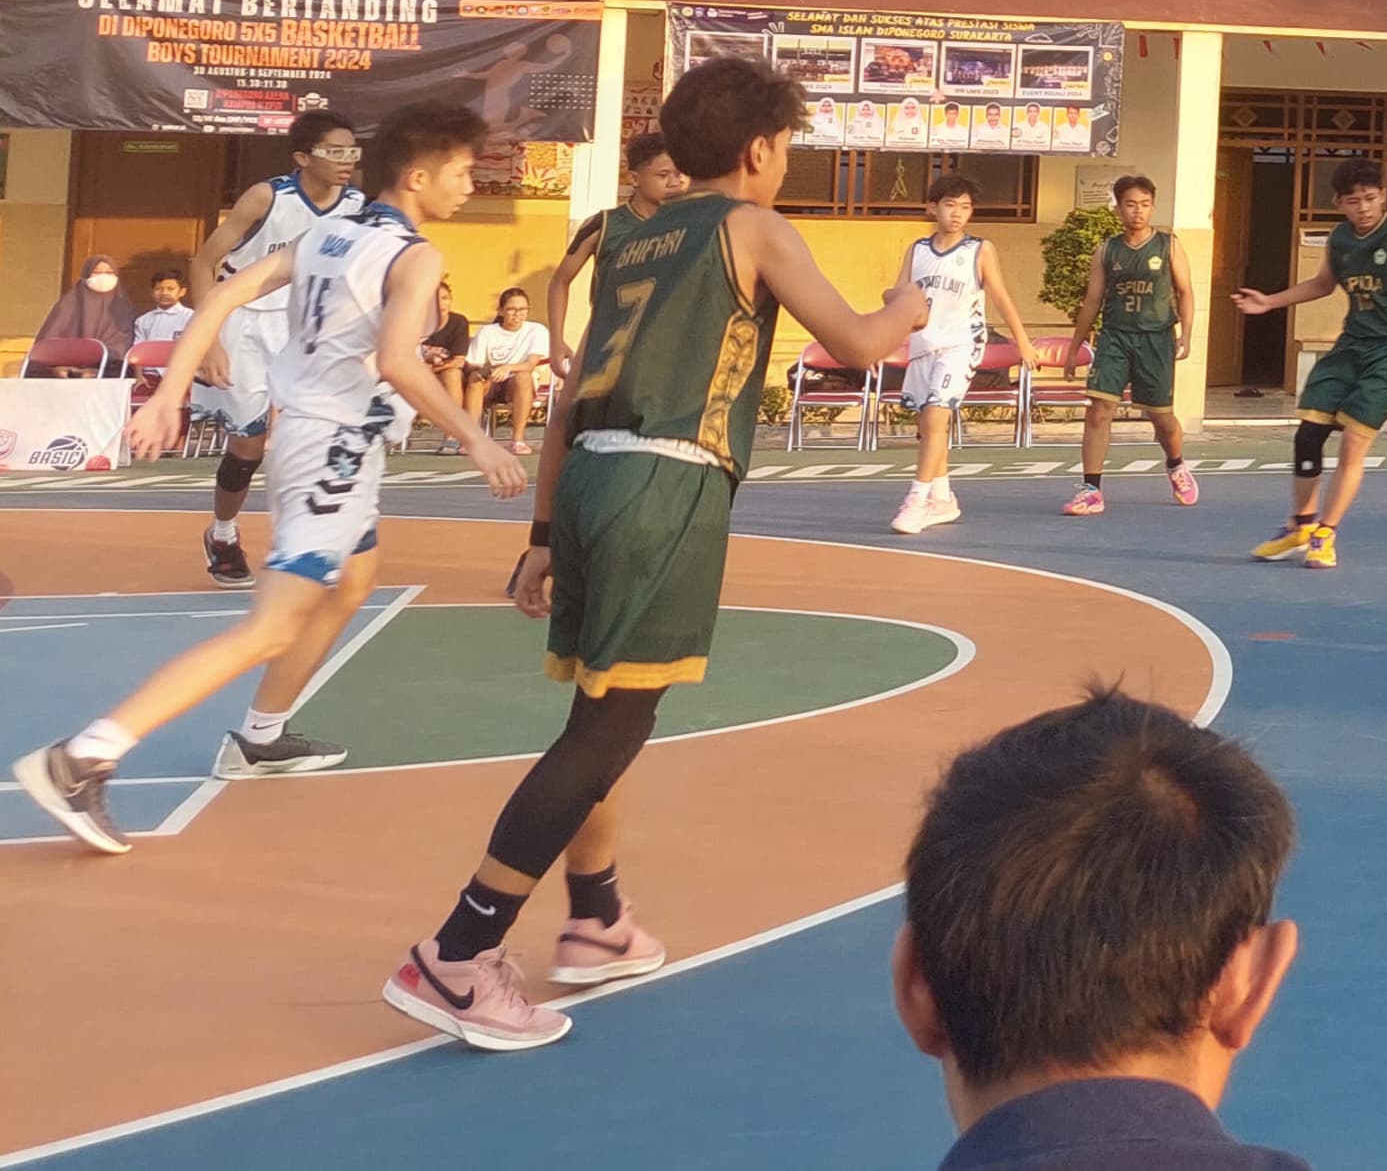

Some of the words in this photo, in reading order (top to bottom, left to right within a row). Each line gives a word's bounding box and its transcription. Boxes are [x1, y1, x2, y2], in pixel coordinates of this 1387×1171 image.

[787, 11, 839, 23] SELAMAT
[843, 13, 868, 24] DAN
[870, 15, 913, 26] SUKSES
[916, 17, 945, 28] ATAS
[947, 19, 1000, 30] PRESTASI
[1003, 22, 1036, 31] SISWA
[98, 15, 118, 37] DI
[121, 15, 237, 42] DIPONEGORO
[240, 22, 278, 43] 5X5
[281, 19, 422, 50] BASKETBALL
[810, 24, 834, 34] SMA
[838, 25, 874, 36] ISLAM
[876, 26, 945, 39] DIPONEGORO
[950, 30, 1013, 42] SURAKARTA
[147, 41, 196, 65] BOYS
[200, 43, 322, 69] TOURNAMENT
[324, 48, 372, 70] 2024
[257, 68, 307, 79] SEPTEMBER
[942, 277, 967, 299] LAUT
[1115, 280, 1154, 295] SPIDA
[1125, 295, 1142, 313] 21
[597, 276, 657, 374] 7
[941, 373, 952, 389] 8
[28, 450, 81, 466] BASIC
